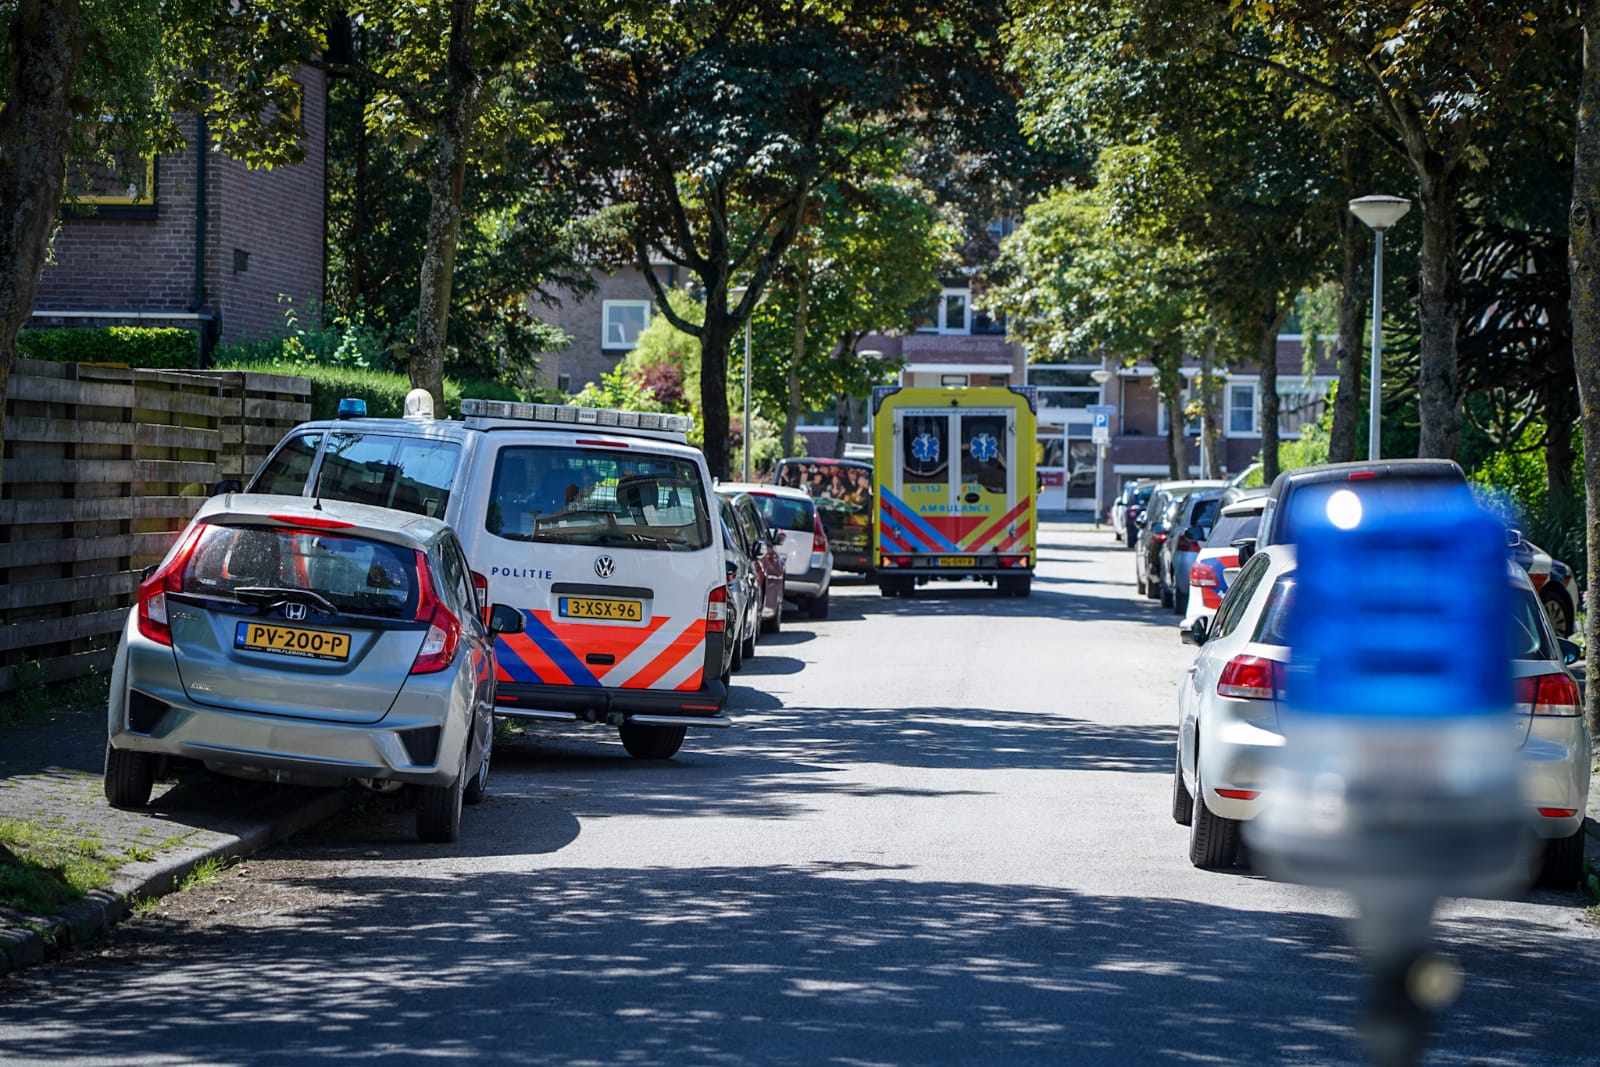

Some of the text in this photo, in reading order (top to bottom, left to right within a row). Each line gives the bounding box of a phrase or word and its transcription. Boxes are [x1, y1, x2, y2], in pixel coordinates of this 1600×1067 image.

[1096, 414, 1105, 427] P
[920, 504, 991, 513] AMBULANCE
[491, 566, 553, 580] POLITIE
[572, 601, 636, 617] 3-XSX-96
[253, 627, 343, 653] PV-200-P
